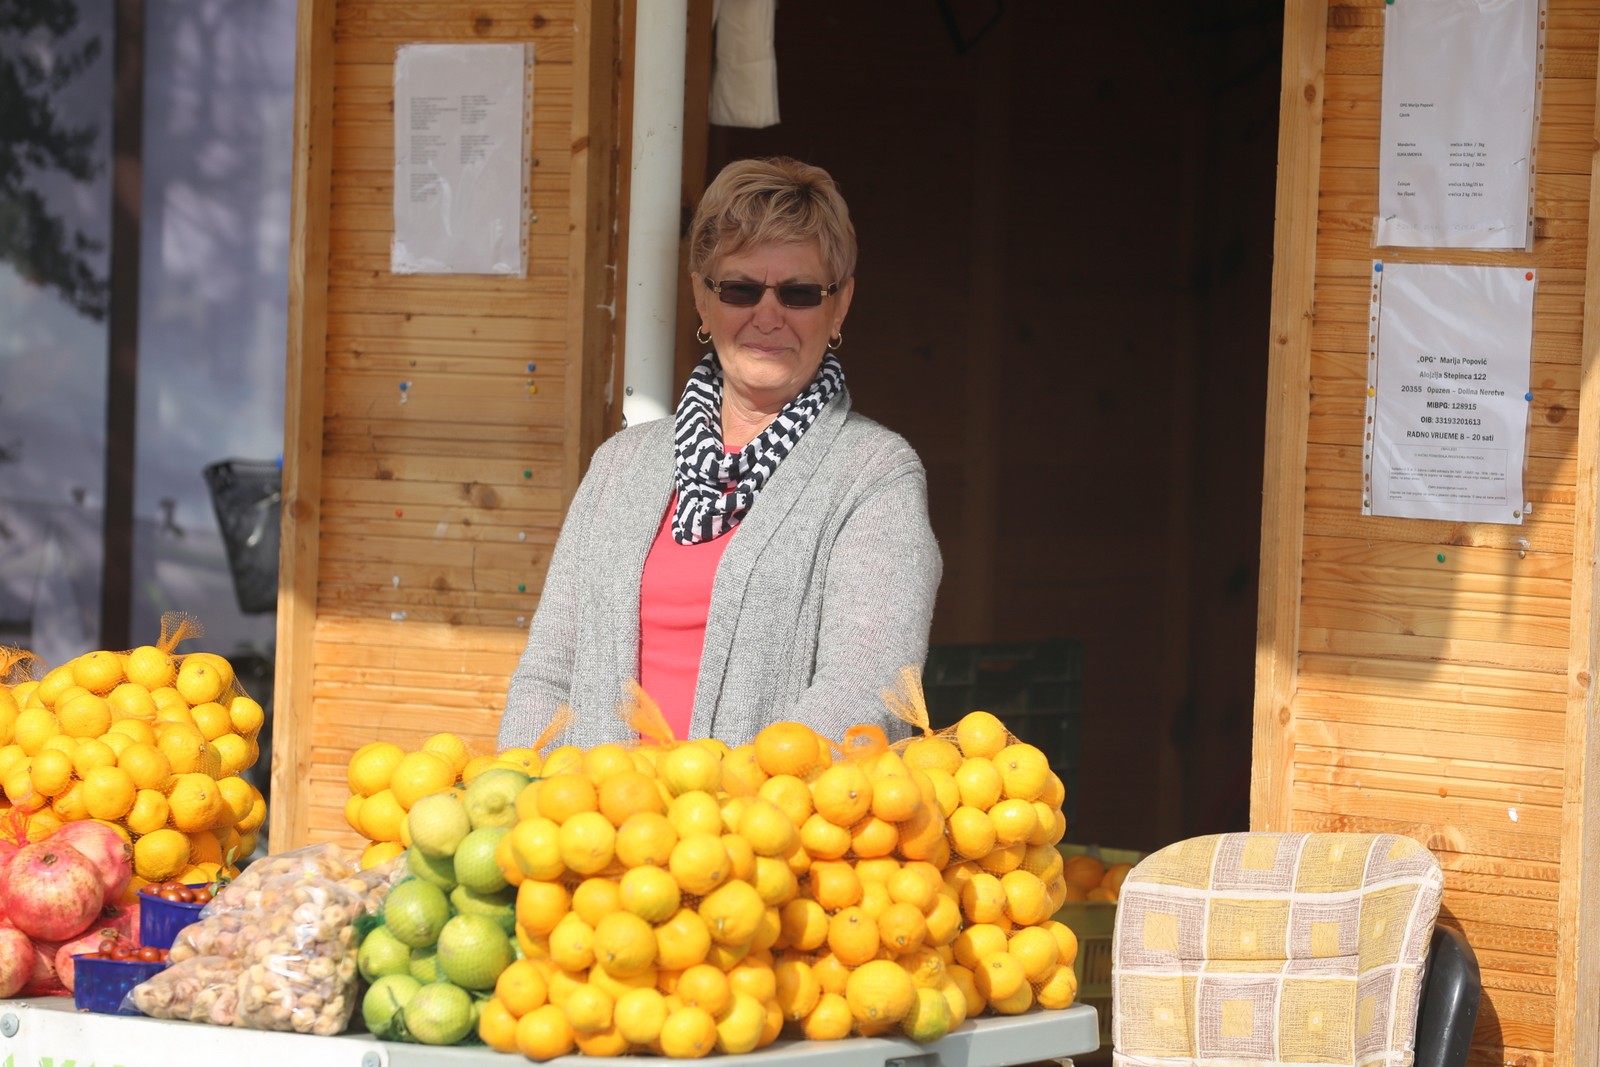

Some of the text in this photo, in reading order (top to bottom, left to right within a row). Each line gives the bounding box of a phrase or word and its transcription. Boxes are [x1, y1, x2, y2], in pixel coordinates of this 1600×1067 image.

[1440, 357, 1460, 365] Marija
[1462, 358, 1487, 366] Popović
[1419, 371, 1442, 379] Alojzija
[1444, 372, 1472, 380] Stepinca
[1426, 386, 1450, 394] Opuzen
[1457, 387, 1478, 395] Dolina
[1426, 401, 1450, 409] MIBPG:
[1435, 417, 1481, 425] 33193201613
[1406, 430, 1430, 438] RADNO
[1431, 432, 1458, 440] VRIJEME
